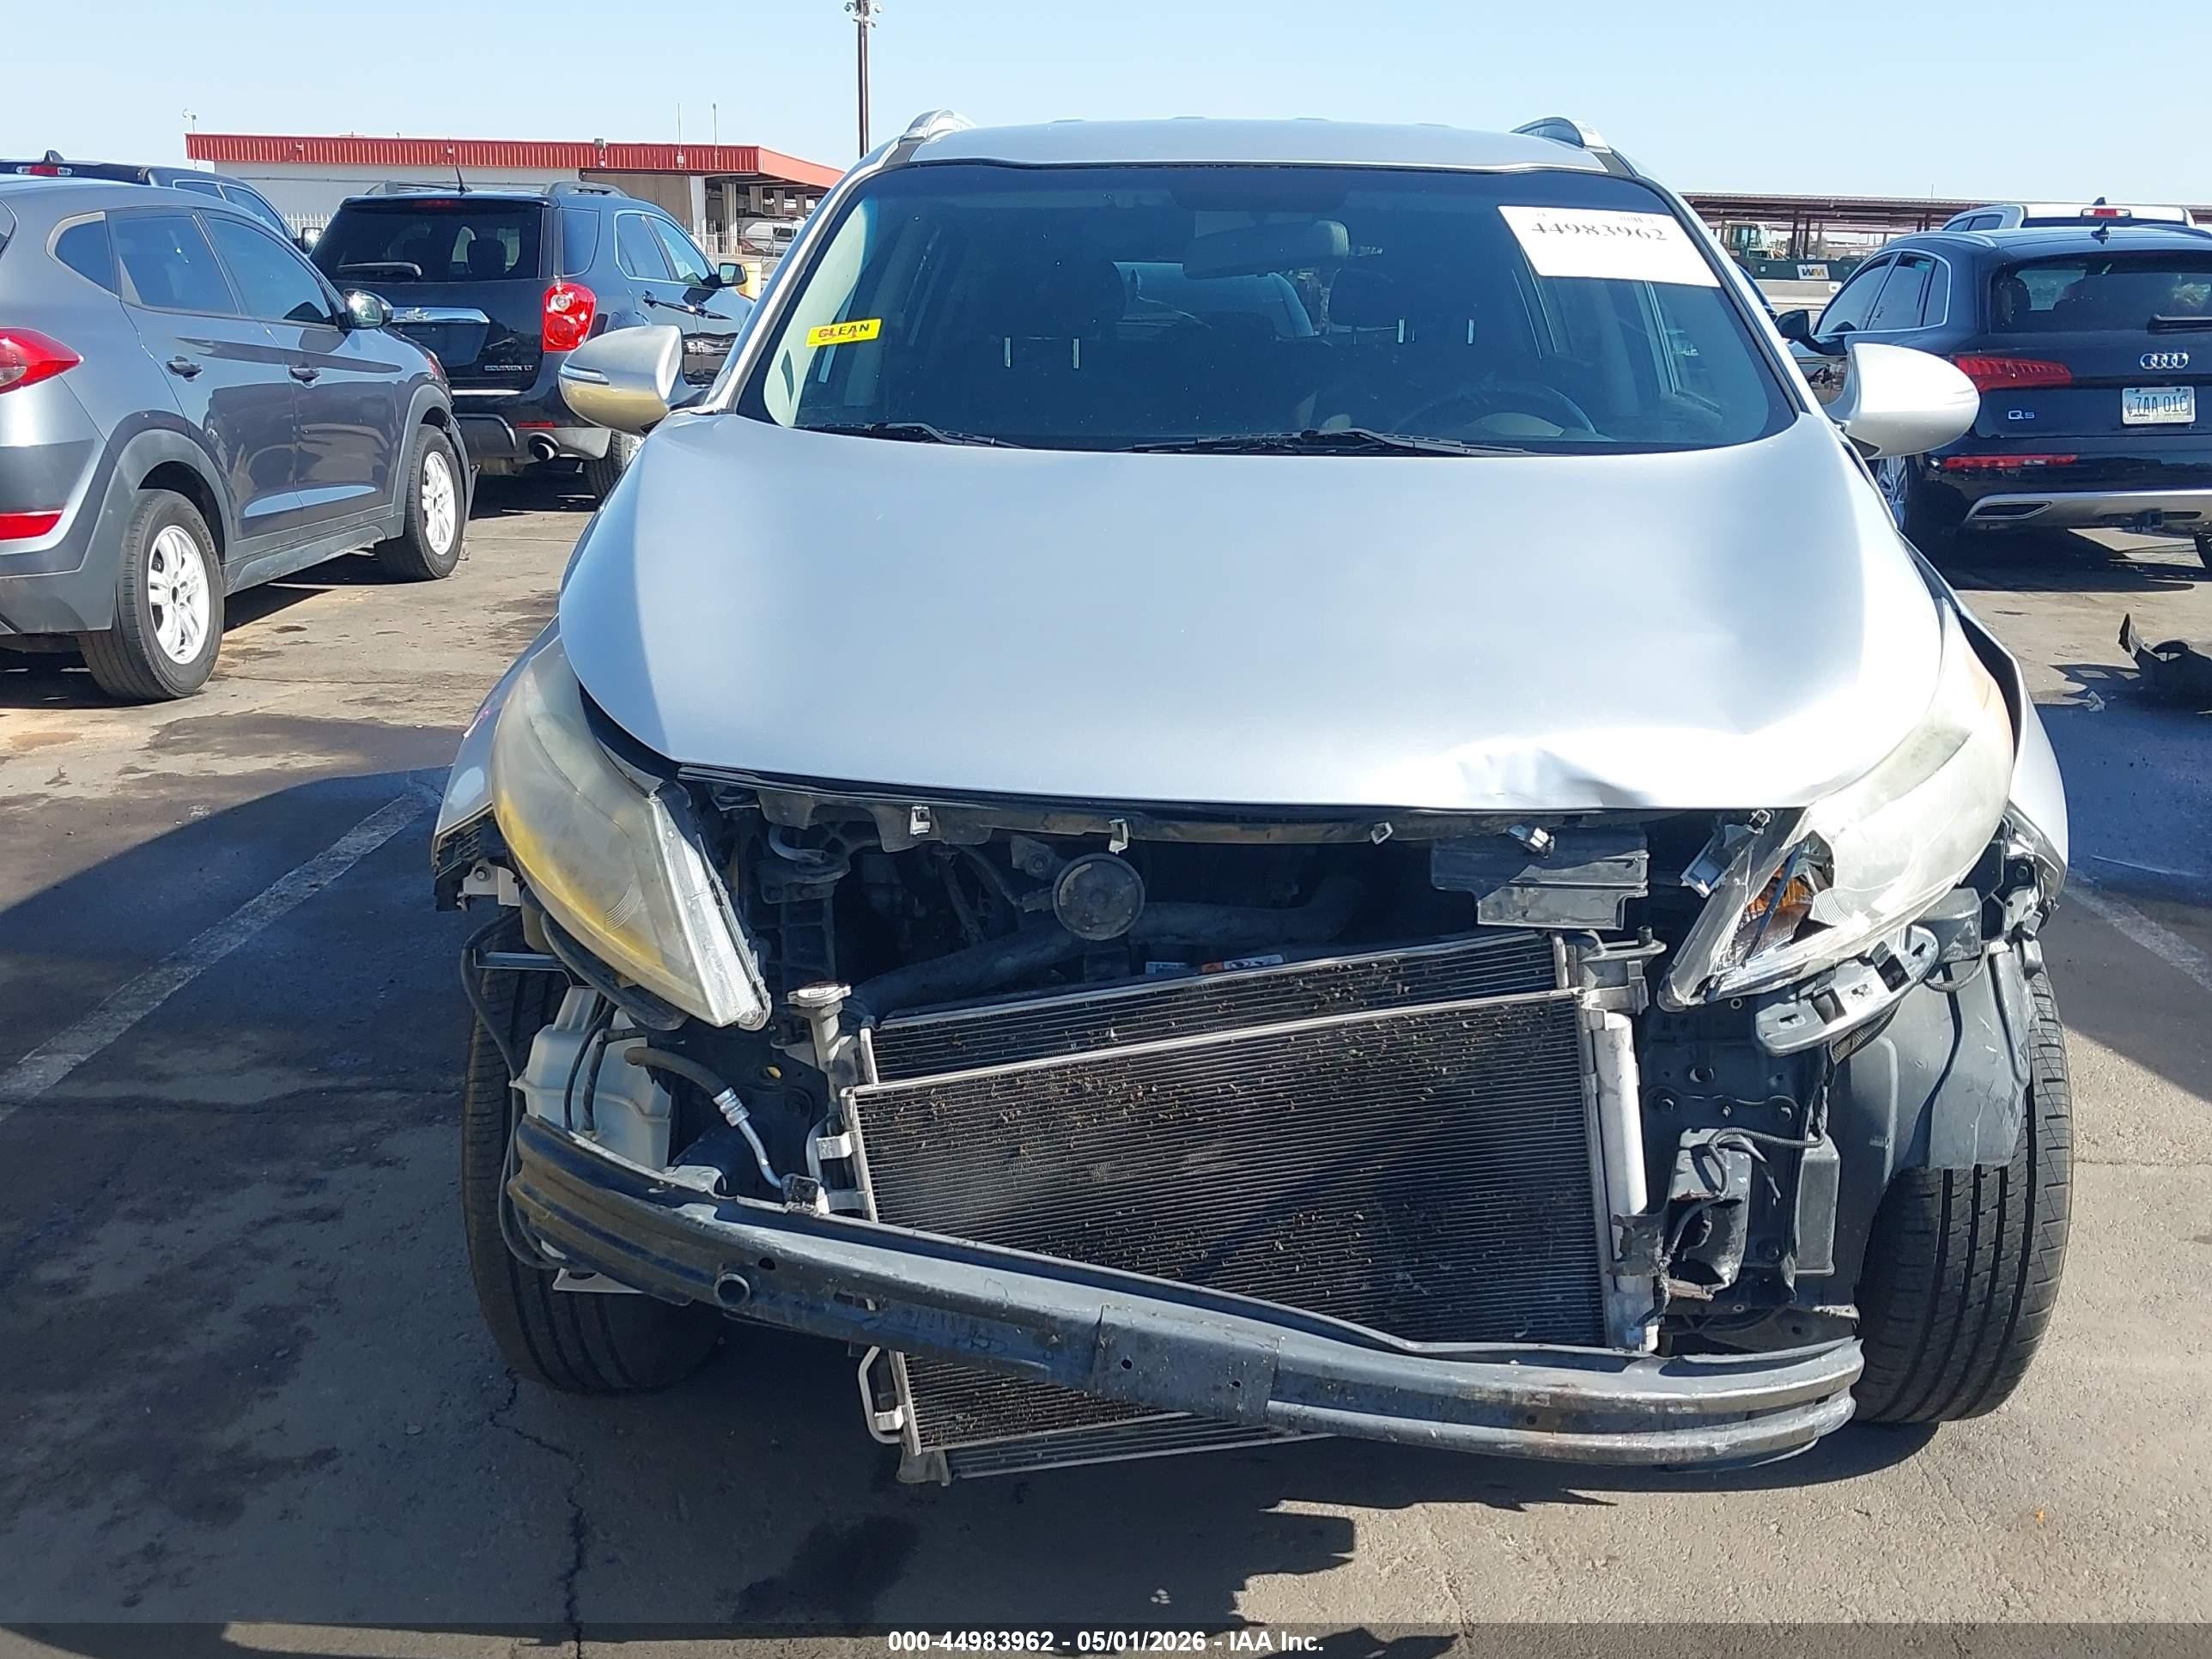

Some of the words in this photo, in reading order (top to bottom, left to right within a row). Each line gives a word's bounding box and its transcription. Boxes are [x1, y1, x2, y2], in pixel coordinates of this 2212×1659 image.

[1531, 222, 1668, 240] 44983962
[1801, 268, 1826, 276] WM
[818, 324, 870, 338] CLEAN
[2135, 396, 2159, 413] 7AA
